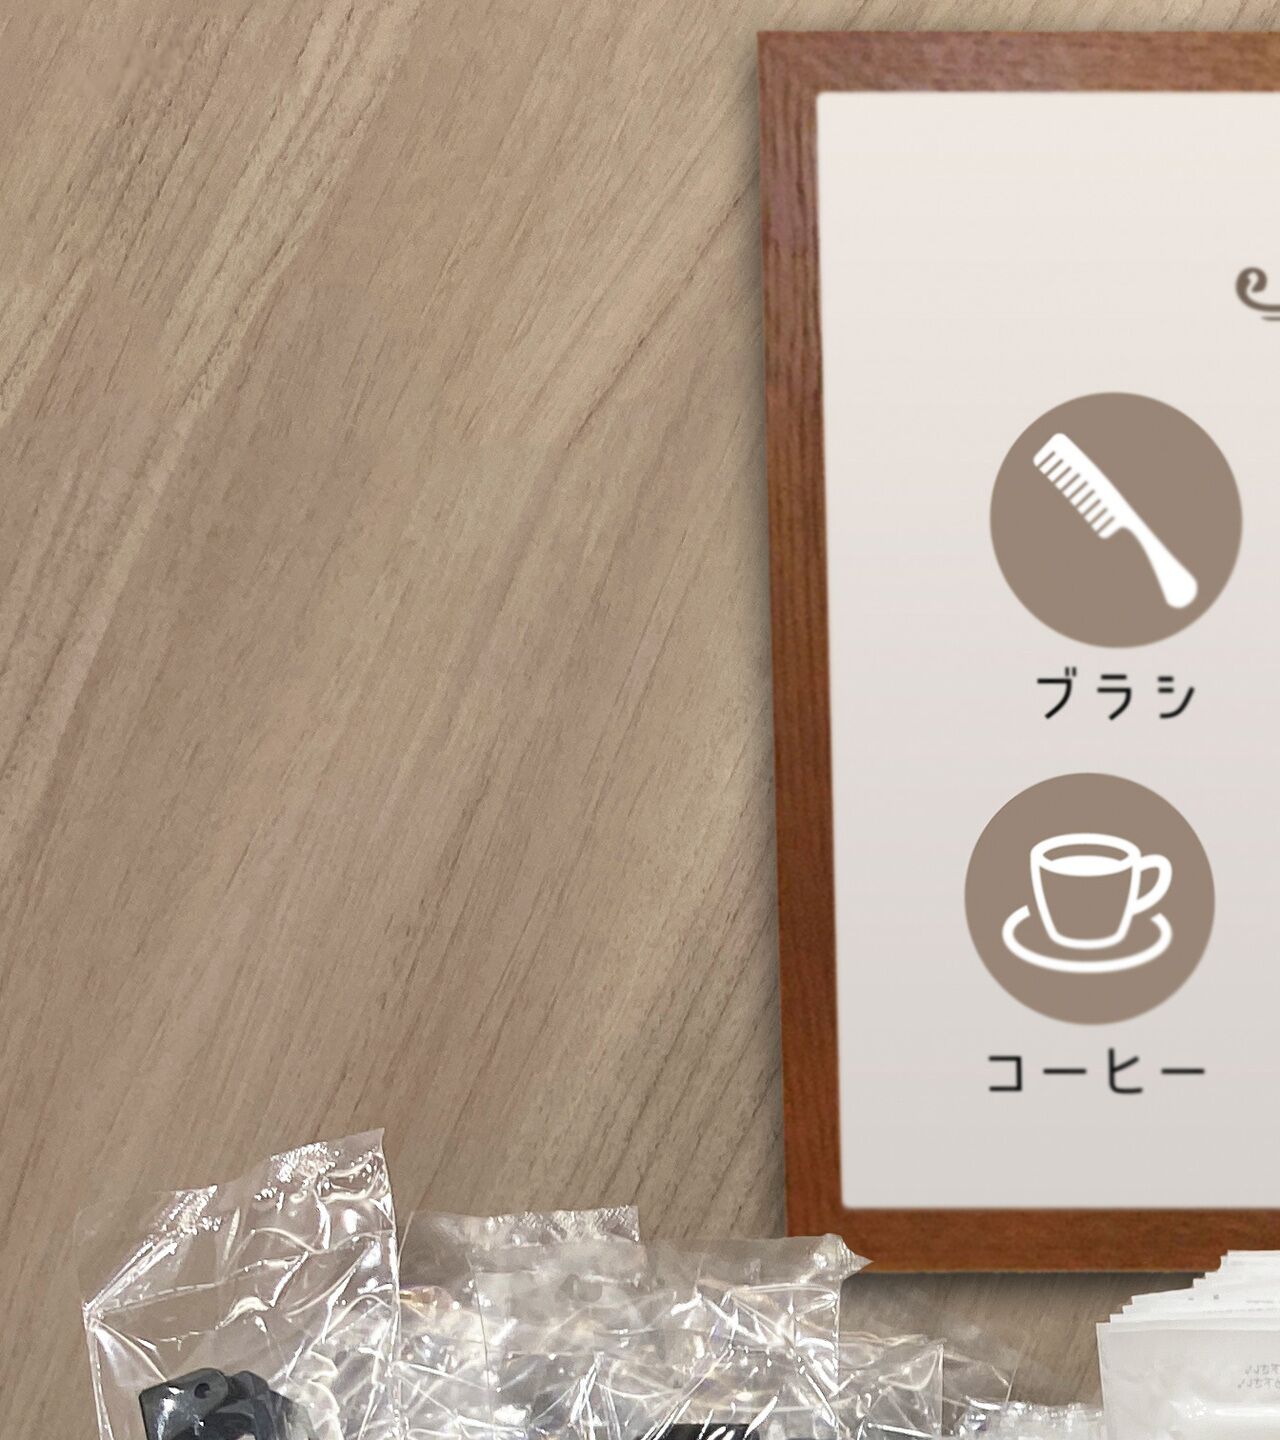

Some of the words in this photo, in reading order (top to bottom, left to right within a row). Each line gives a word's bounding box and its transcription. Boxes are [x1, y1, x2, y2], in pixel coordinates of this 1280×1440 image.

[1036, 666, 1196, 722] ブラシ
[987, 1047, 1207, 1096] コーヒー
